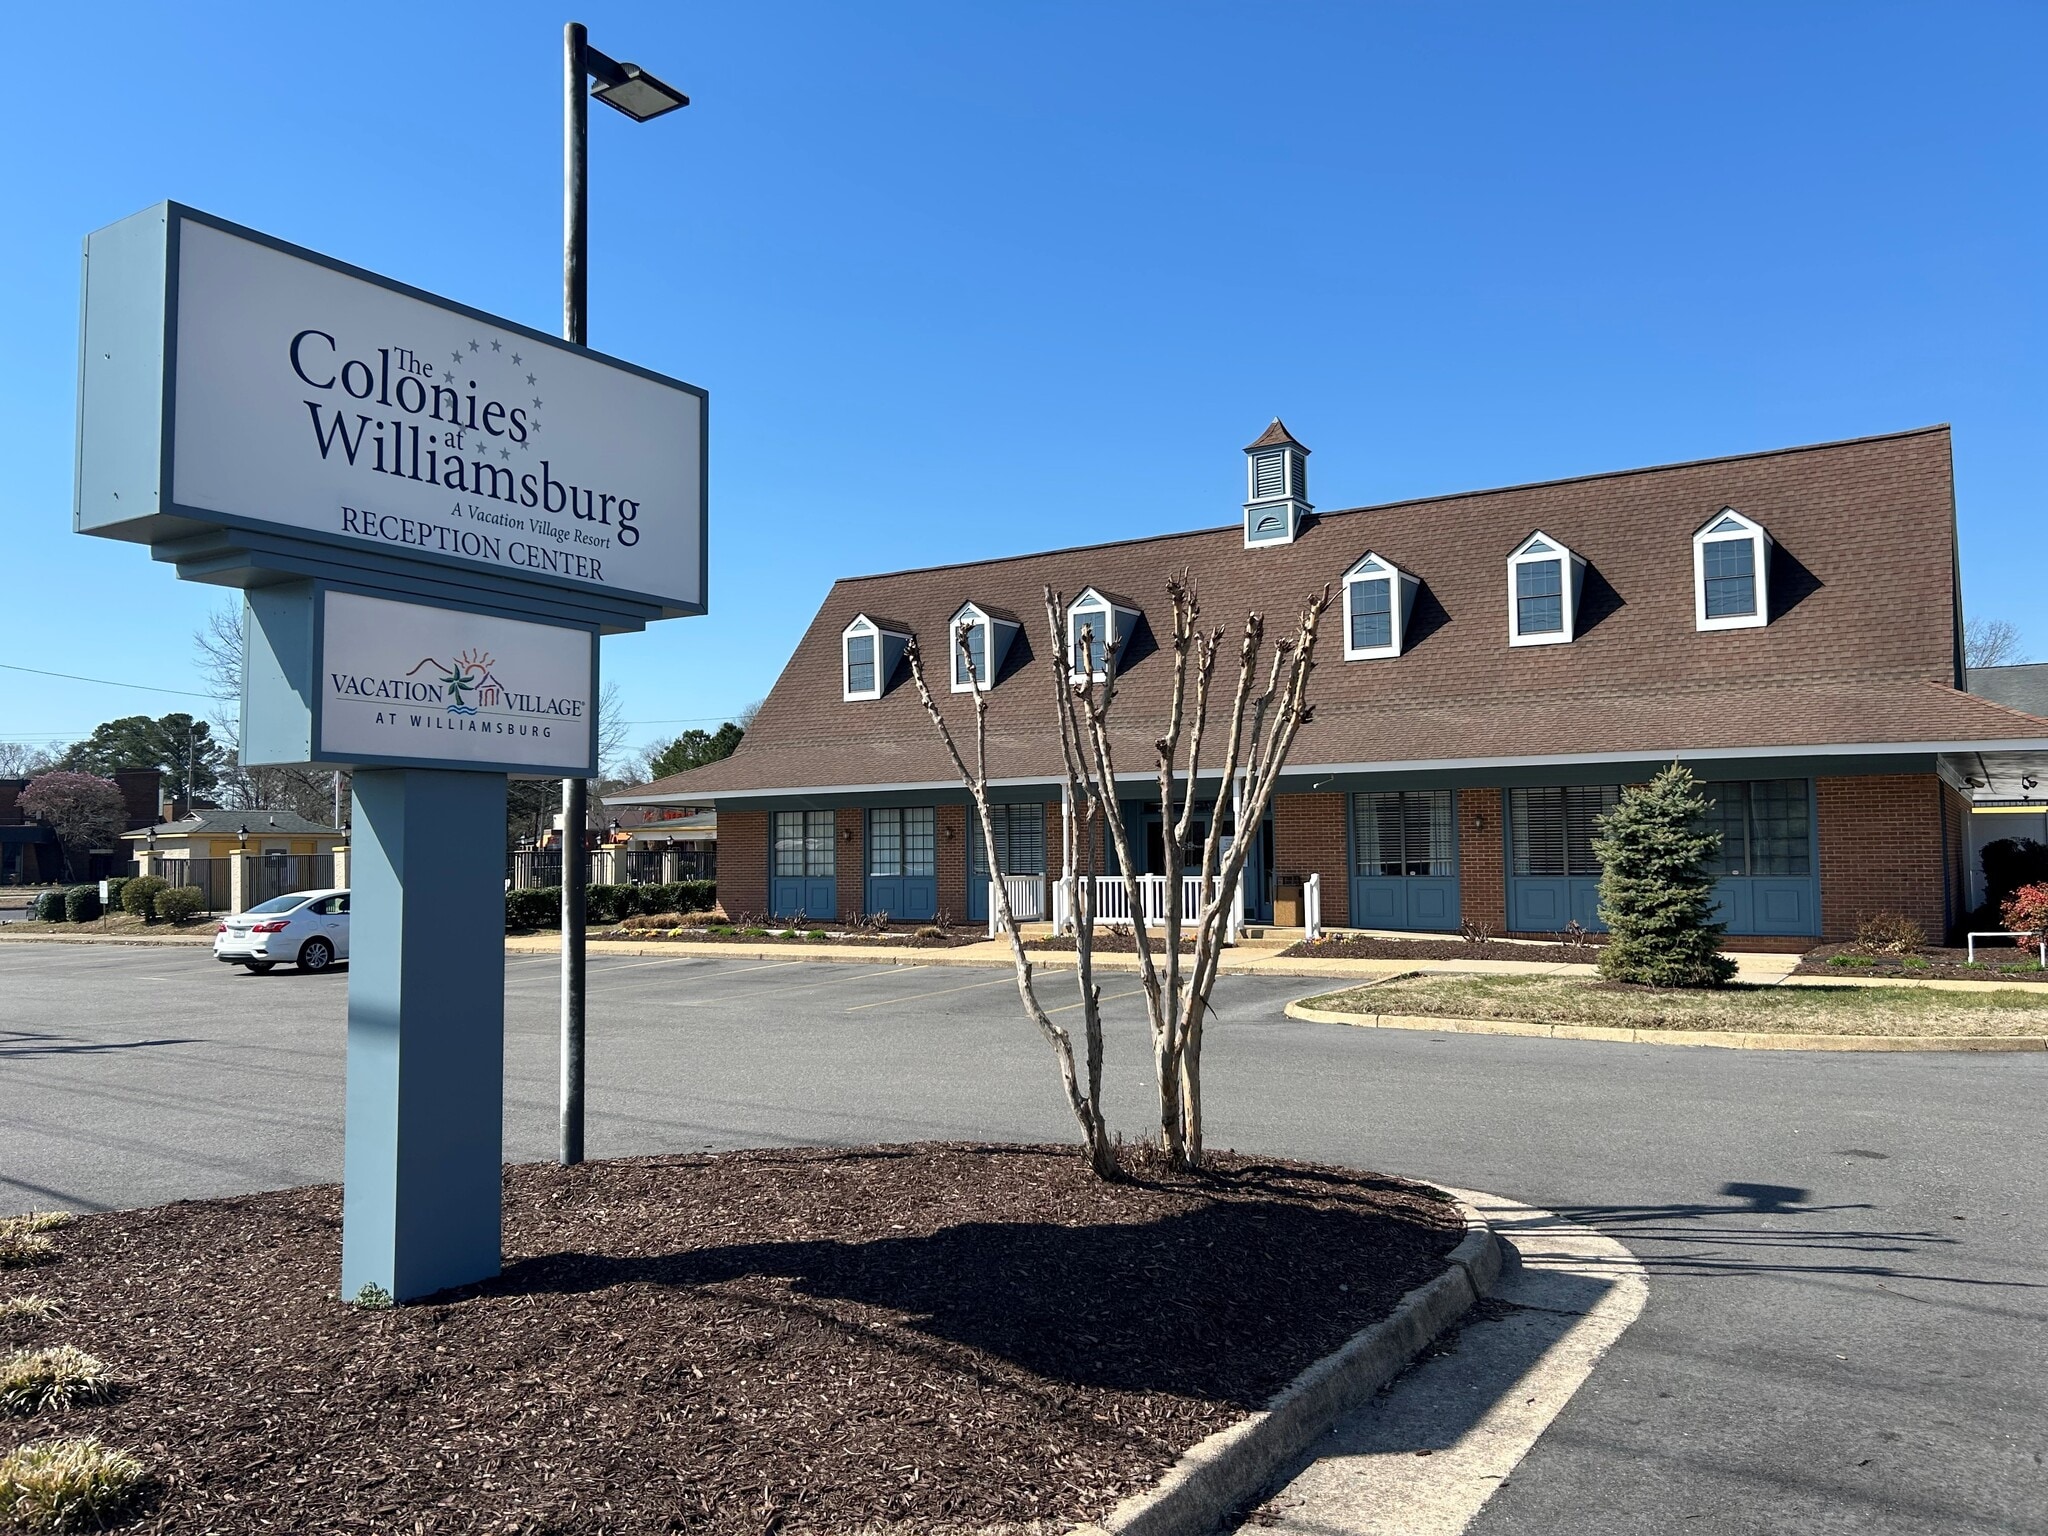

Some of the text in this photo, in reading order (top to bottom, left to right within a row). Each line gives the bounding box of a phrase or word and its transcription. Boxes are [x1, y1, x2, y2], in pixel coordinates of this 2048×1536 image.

[393, 346, 433, 378] The
[289, 329, 528, 443] Colonies
[444, 429, 464, 451] at
[303, 400, 640, 547] Williamsburg
[341, 506, 605, 581] RECEPTION CENTER
[451, 502, 611, 549] A Vacation Village Resort
[331, 673, 443, 703] VACATION
[376, 712, 551, 738] AT WILLIAMSBURG
